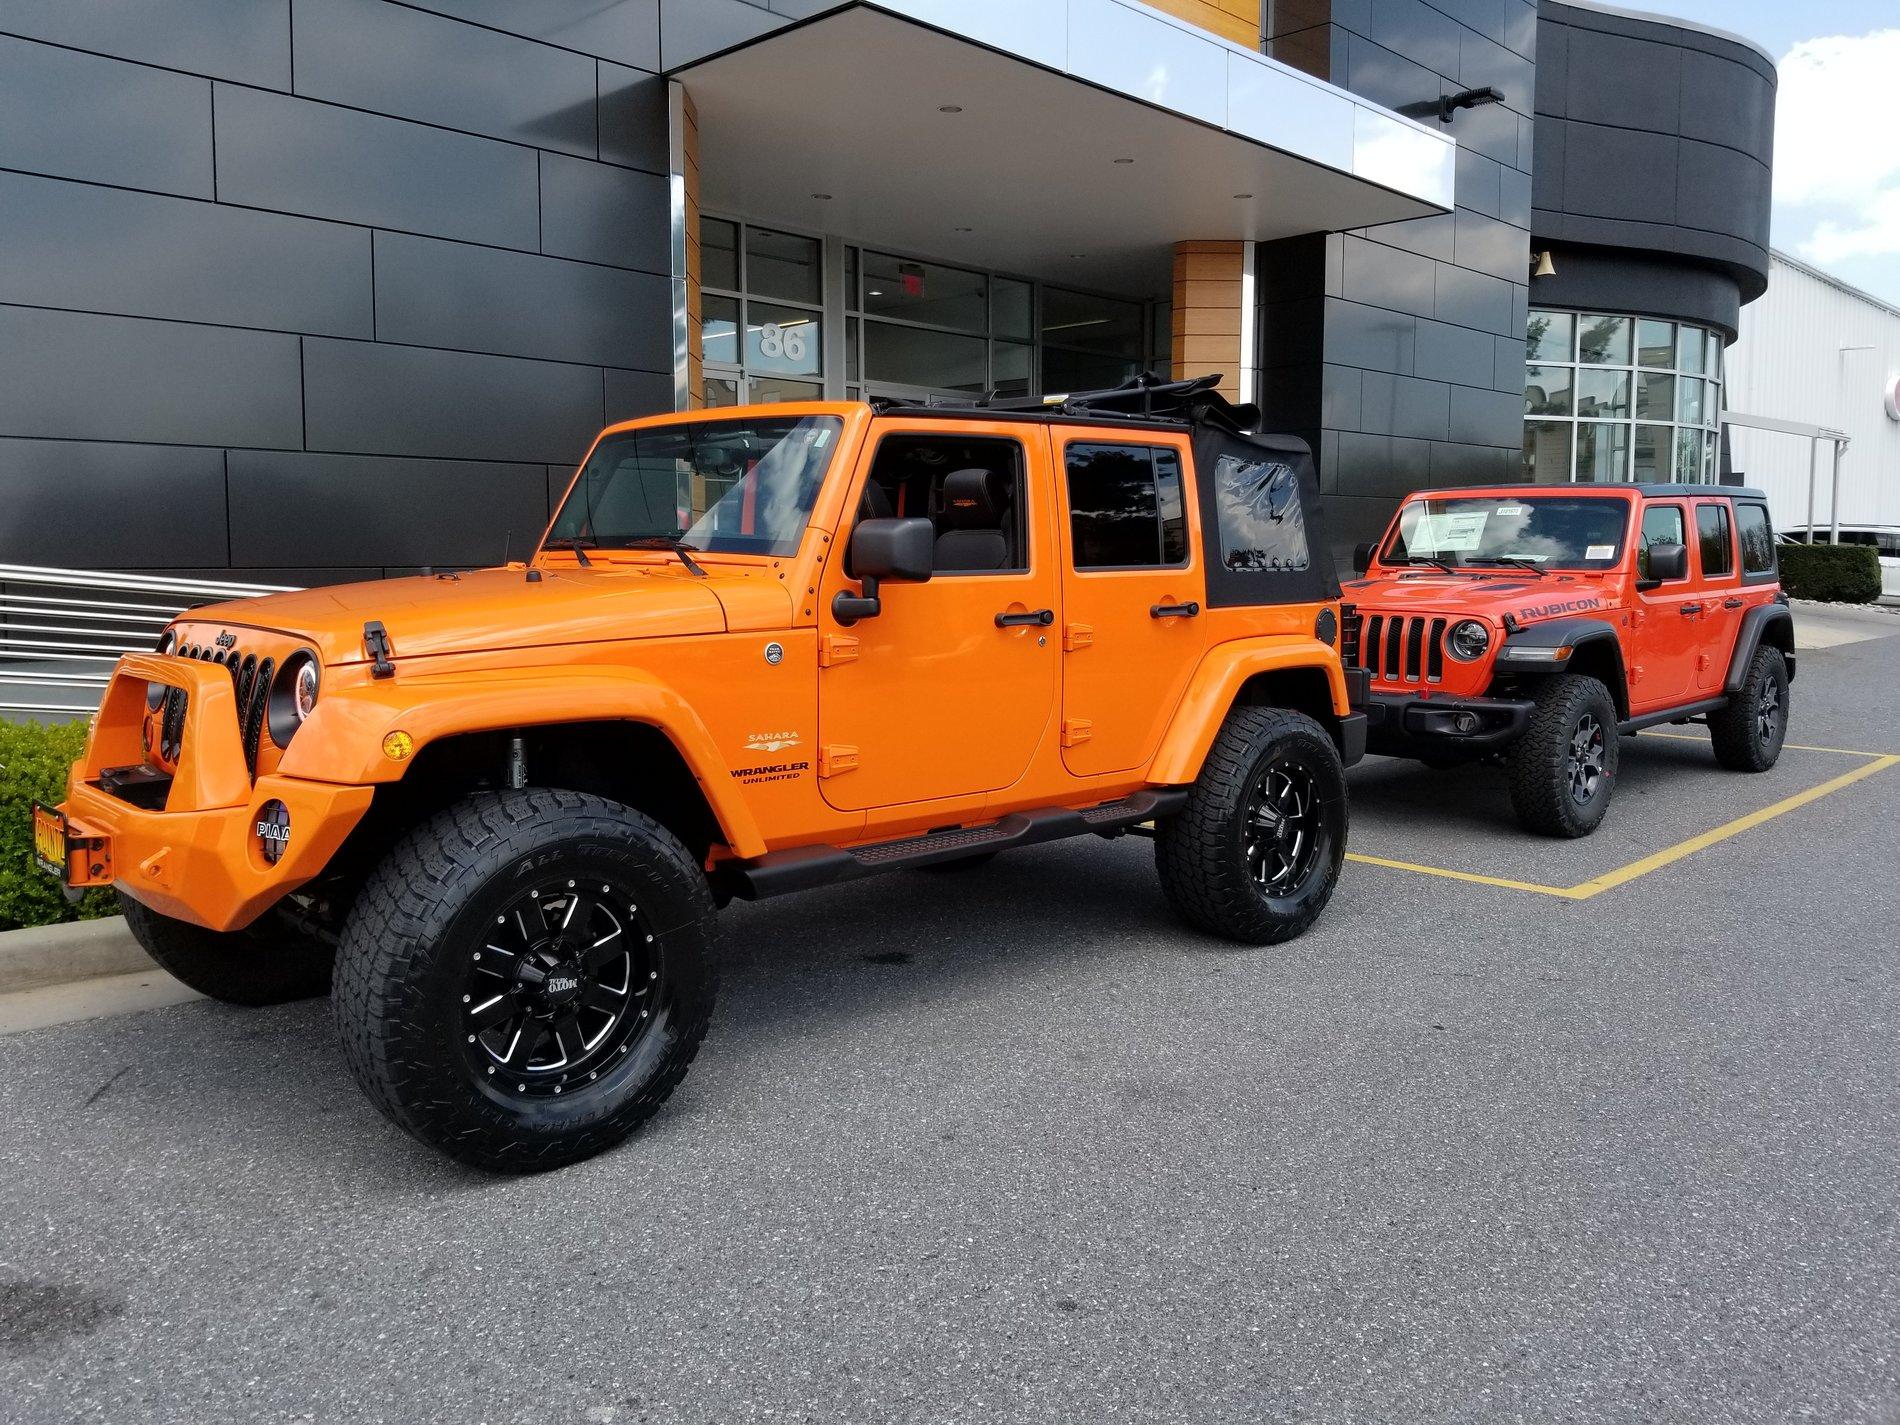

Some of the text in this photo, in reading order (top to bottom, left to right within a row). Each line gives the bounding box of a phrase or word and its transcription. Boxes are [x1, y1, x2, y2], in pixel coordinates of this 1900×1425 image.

[760, 322, 806, 361] 86
[1520, 599, 1600, 620] RUBICON
[215, 629, 237, 651] Jeep
[748, 731, 799, 742] SAHARA
[730, 761, 809, 778] WRANGLER
[742, 772, 800, 785] UNLIMITED
[256, 821, 290, 841] PIAA
[548, 978, 578, 993] MOTO
